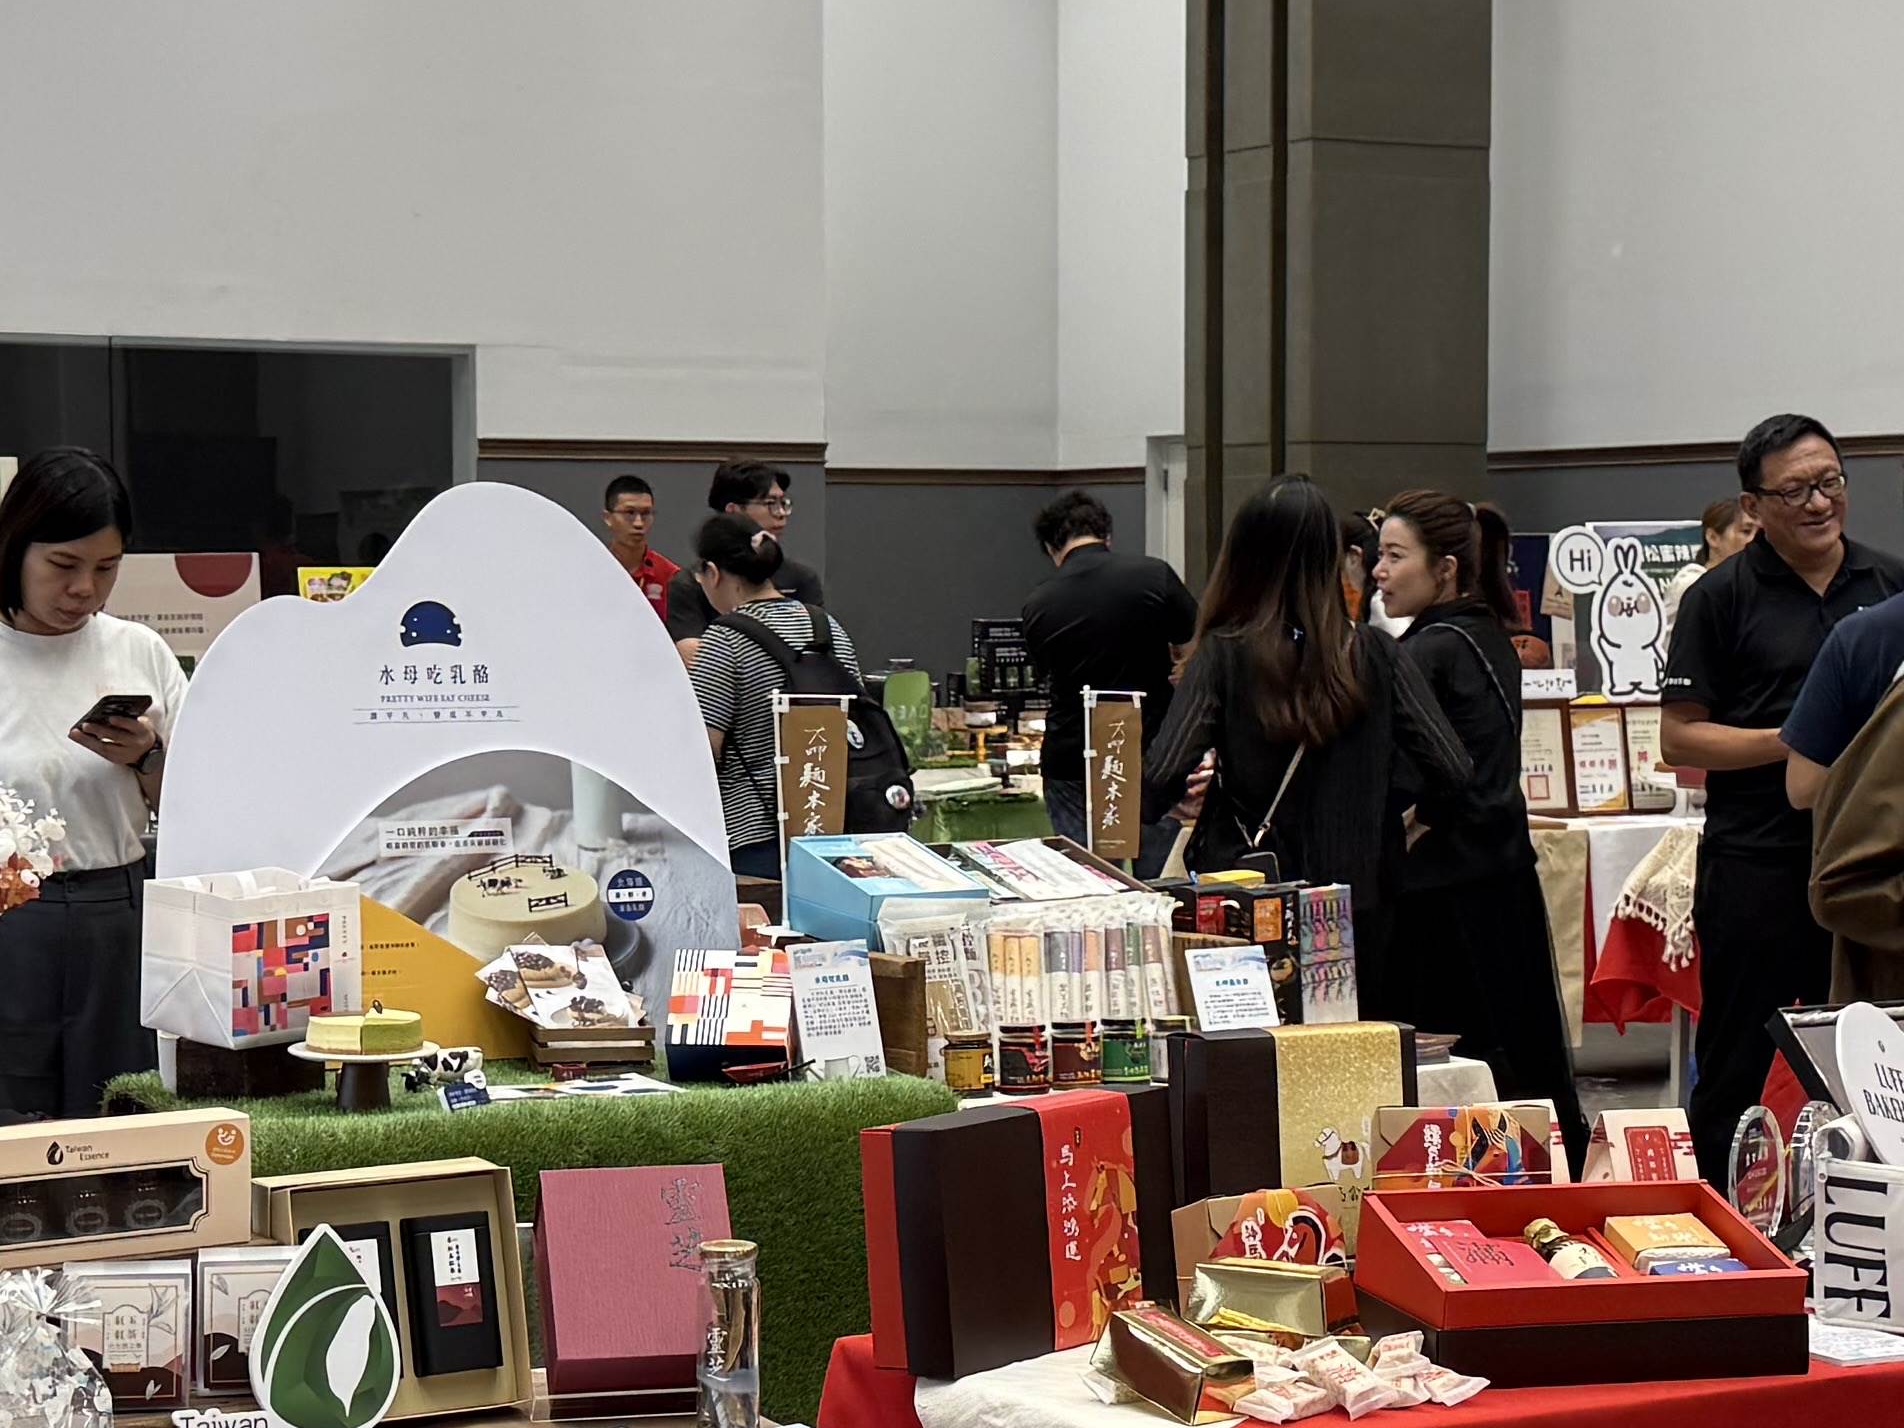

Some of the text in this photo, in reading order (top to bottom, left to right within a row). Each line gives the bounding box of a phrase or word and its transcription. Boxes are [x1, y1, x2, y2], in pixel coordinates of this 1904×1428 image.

[1569, 549, 1592, 572] Hi
[380, 664, 489, 685] 水母吃乳酪
[65, 1144, 93, 1154] Taiwan
[79, 1151, 110, 1161] Essence
[1823, 1175, 1892, 1321] LUFF
